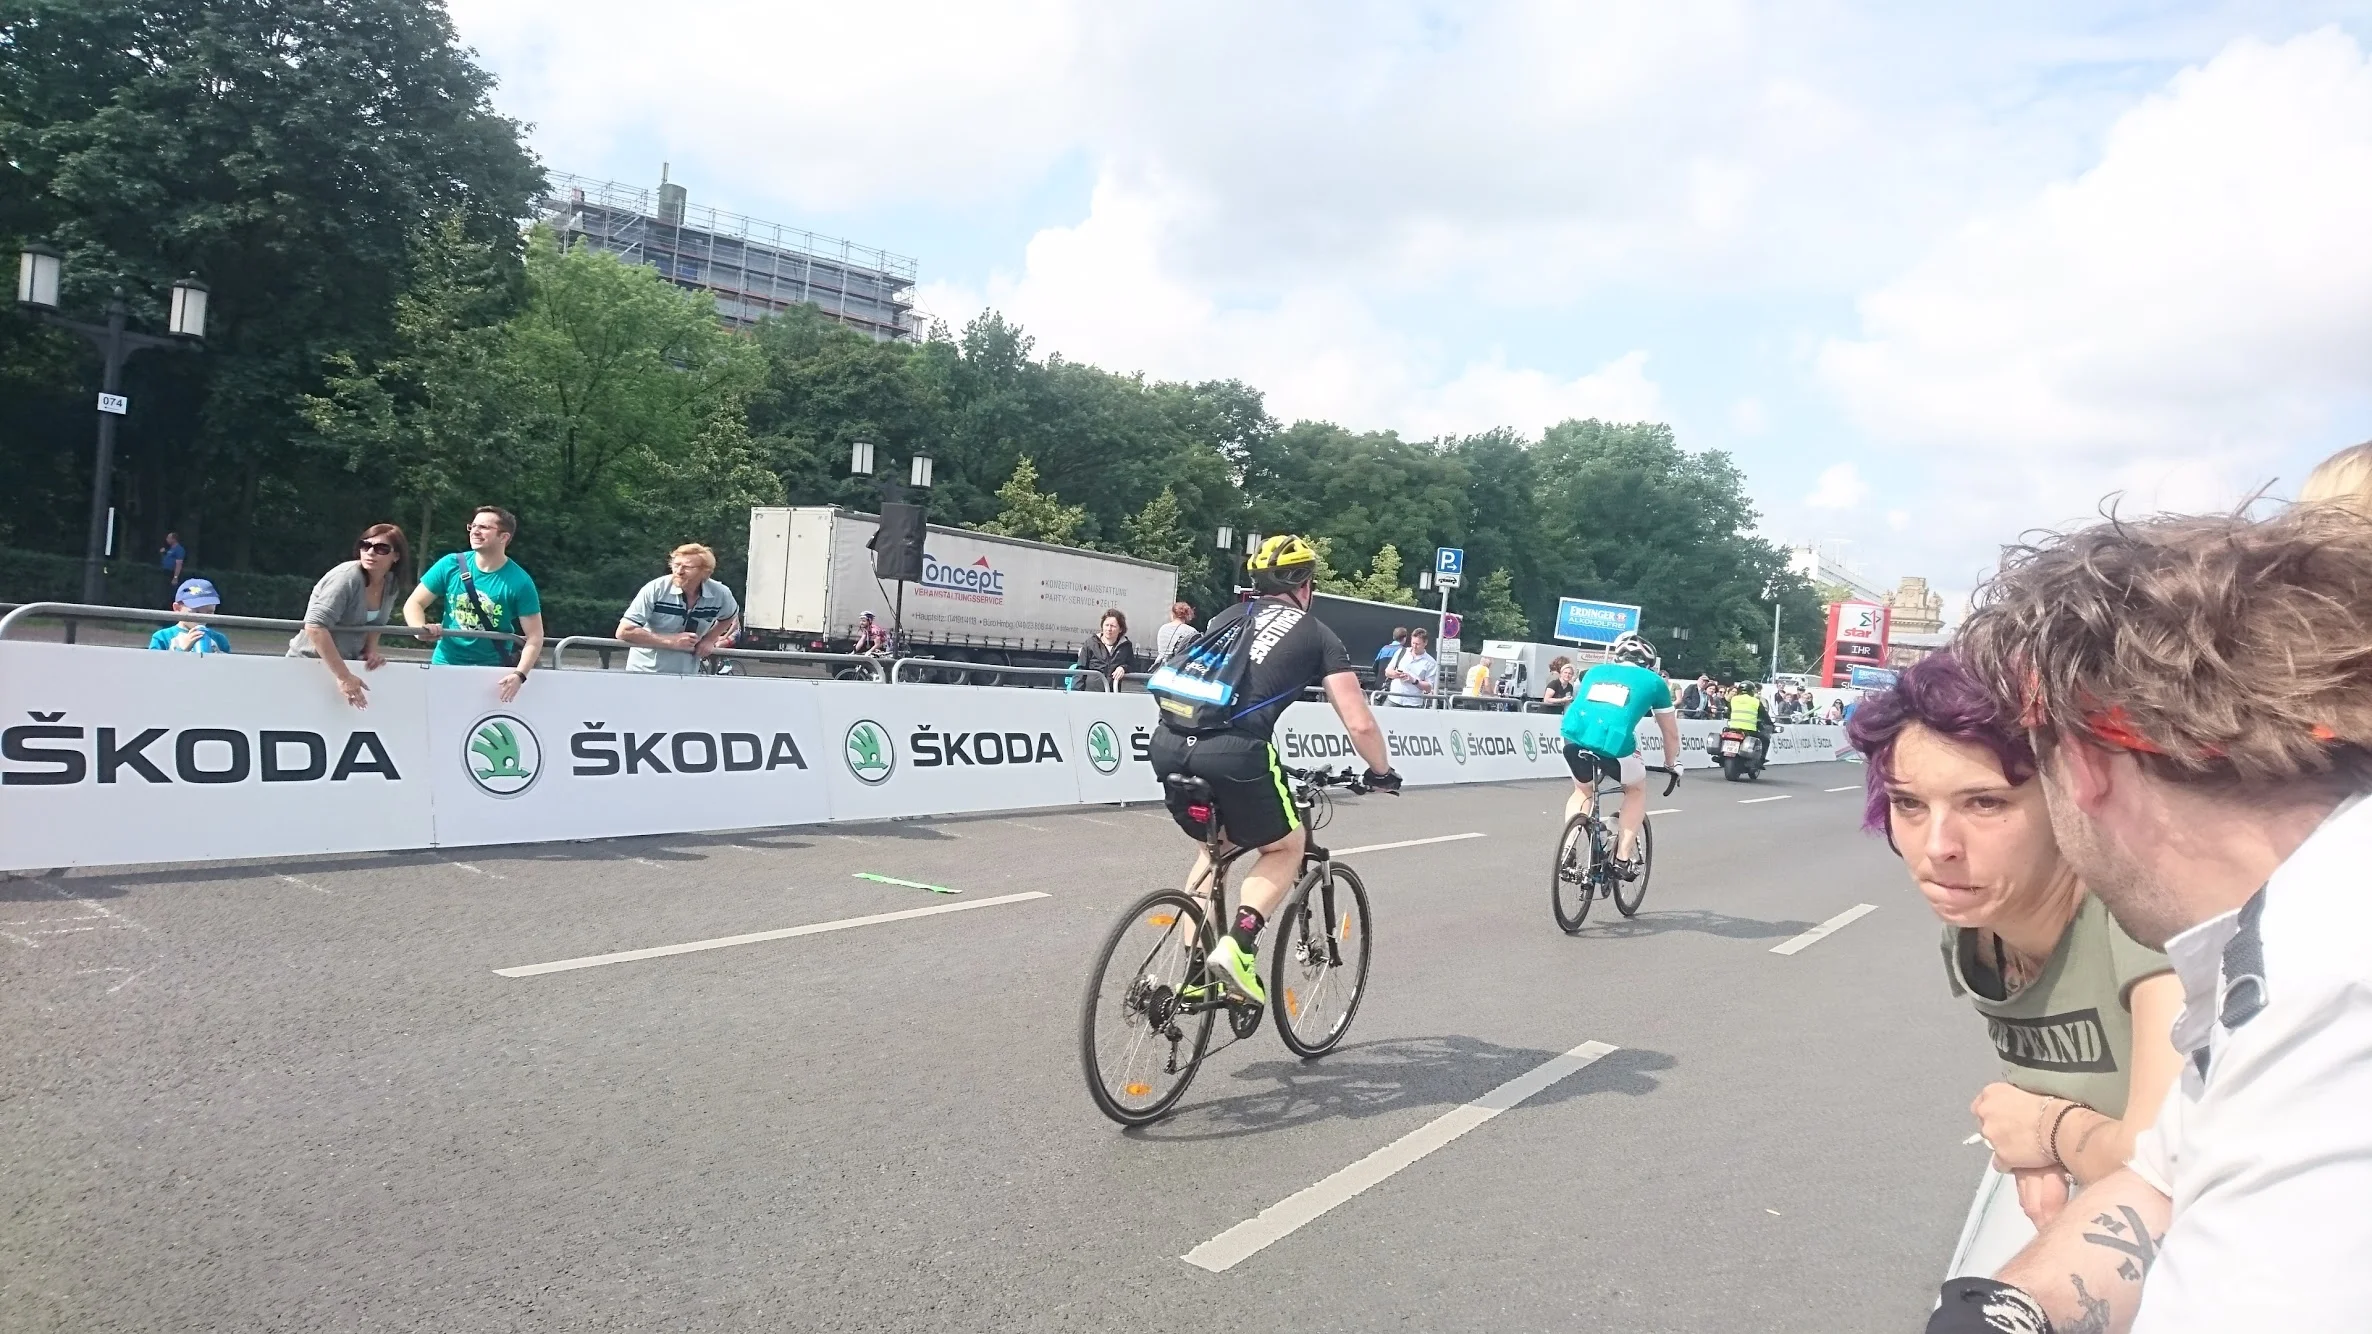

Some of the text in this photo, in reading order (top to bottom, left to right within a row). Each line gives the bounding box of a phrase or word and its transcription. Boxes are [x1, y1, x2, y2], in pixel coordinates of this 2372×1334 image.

[103, 397, 122, 407] 074
[1440, 551, 1456, 570] P
[914, 587, 1003, 605] VERANSTALTUNGSSERVICE
[1100, 600, 1118, 608] ZELTE
[1568, 617, 1626, 629] ALKOHOLFREI
[1570, 606, 1616, 622] ERDINGER
[1843, 627, 1872, 638] star
[1851, 645, 1871, 655] IHR
[1, 711, 401, 786] ŠKODA
[570, 721, 809, 776] ŠKODA
[910, 725, 1064, 767] ŠKODA
[1285, 728, 1357, 758] ŠKODA
[1388, 730, 1444, 756] ŠKODA
[1467, 732, 1517, 756] ŠKODA
[1681, 734, 1705, 750] ŠKODA
